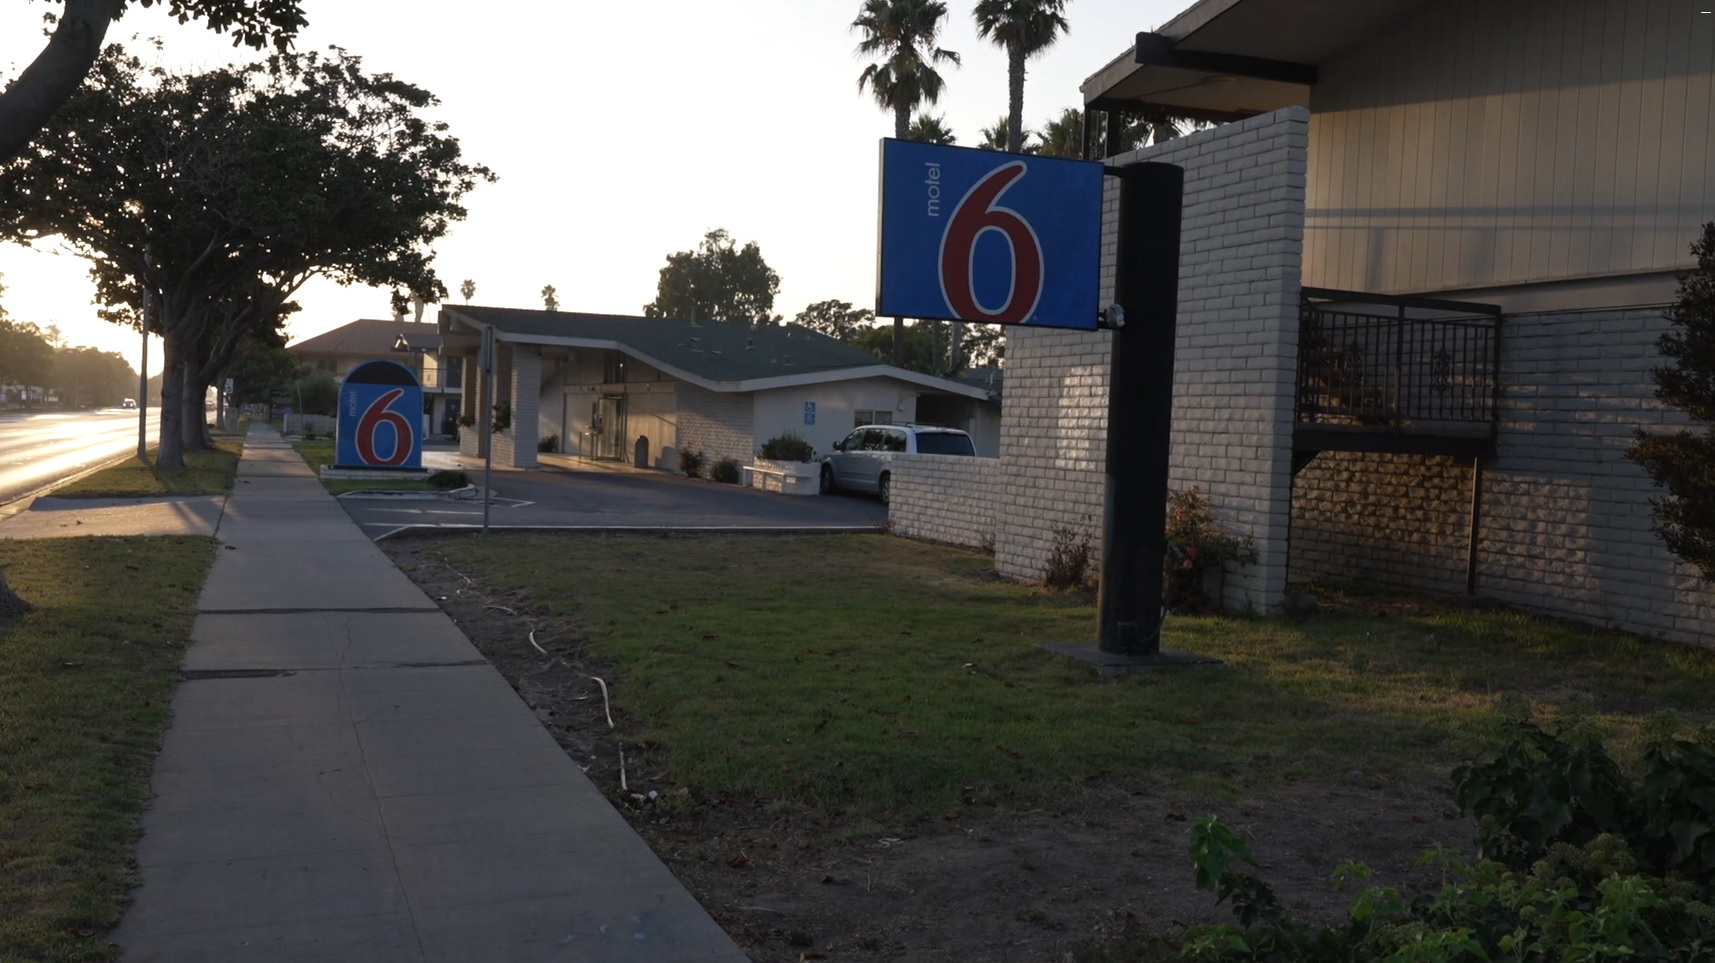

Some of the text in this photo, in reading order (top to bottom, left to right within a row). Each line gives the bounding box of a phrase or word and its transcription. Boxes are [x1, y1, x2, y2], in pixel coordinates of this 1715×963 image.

[925, 162, 941, 217] motel
[938, 160, 1045, 324] 6
[348, 391, 358, 417] motel
[355, 388, 414, 466] 6
